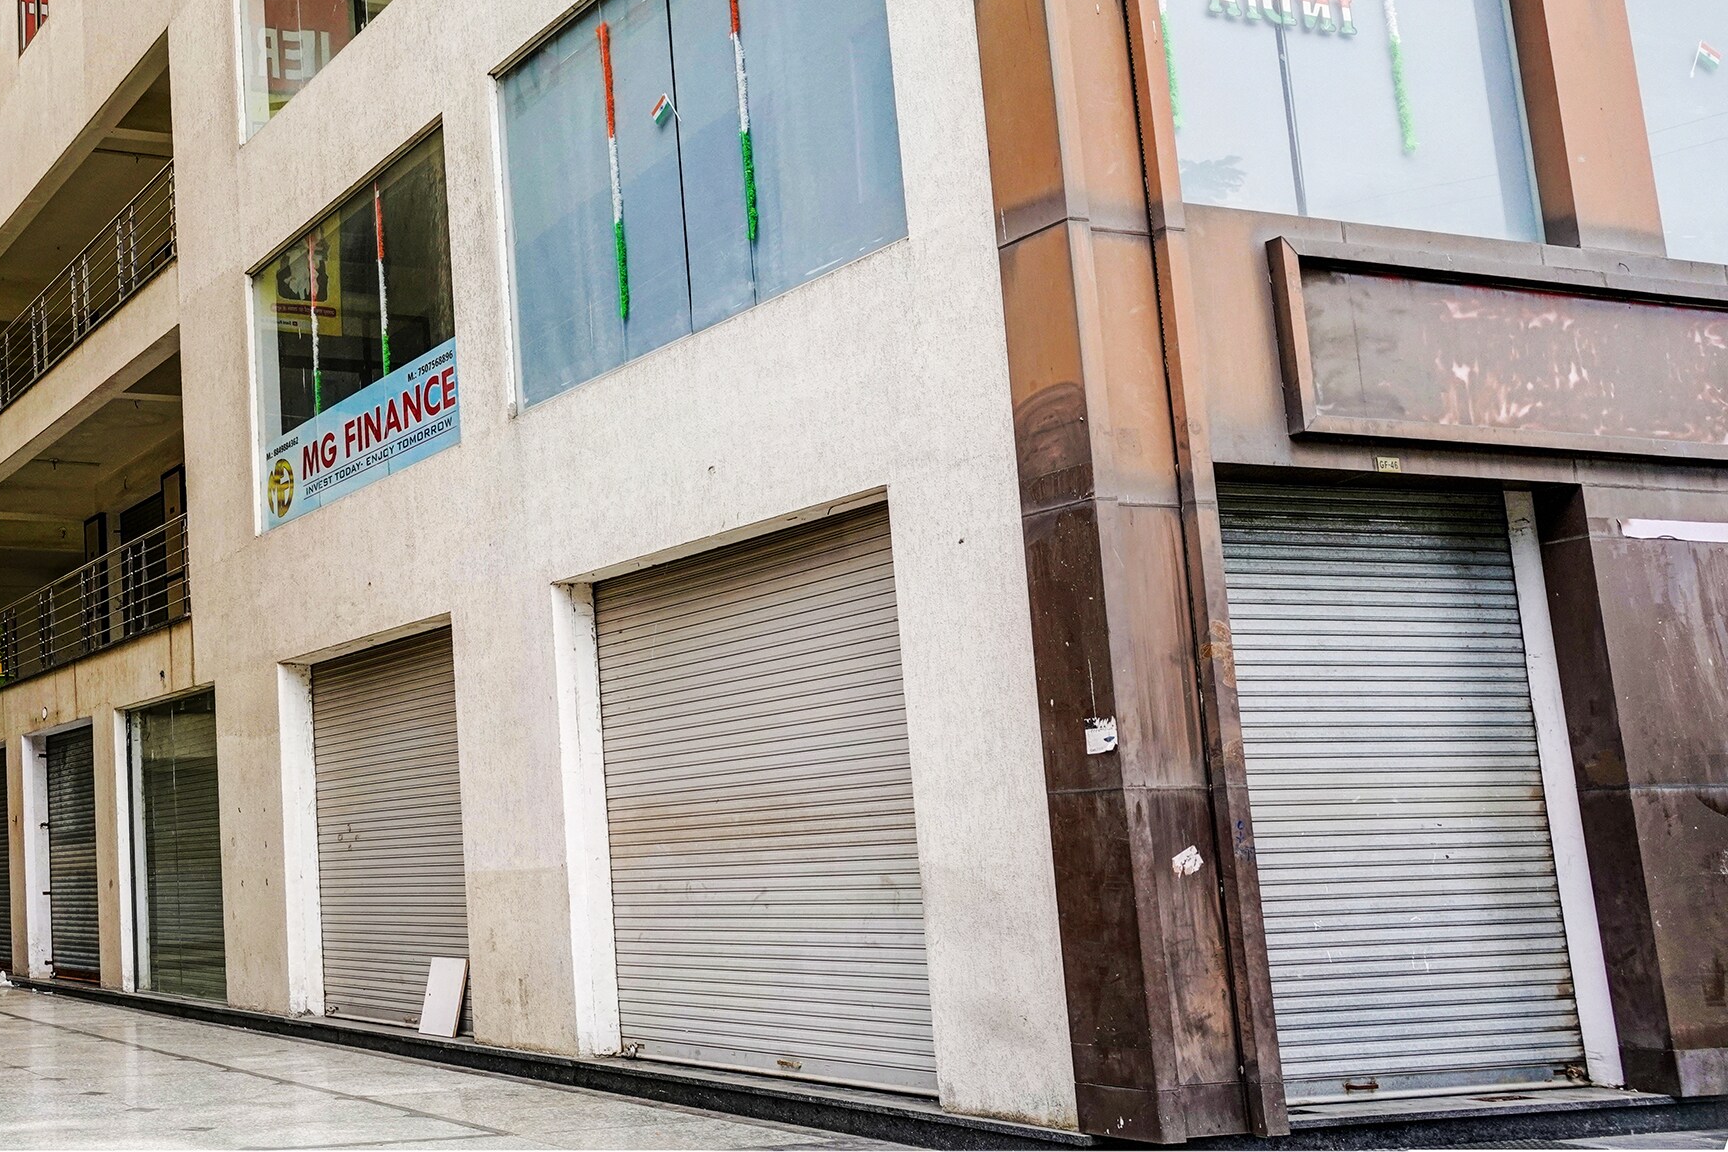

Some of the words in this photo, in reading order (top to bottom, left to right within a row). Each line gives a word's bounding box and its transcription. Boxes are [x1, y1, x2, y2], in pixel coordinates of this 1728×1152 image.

[302, 432, 338, 481] MG
[344, 366, 457, 459] FINANCE
[306, 477, 333, 496] INVEST
[366, 445, 395, 466] ENJOY
[397, 416, 454, 449] TOMORROW
[1379, 460, 1399, 470] GF-46
